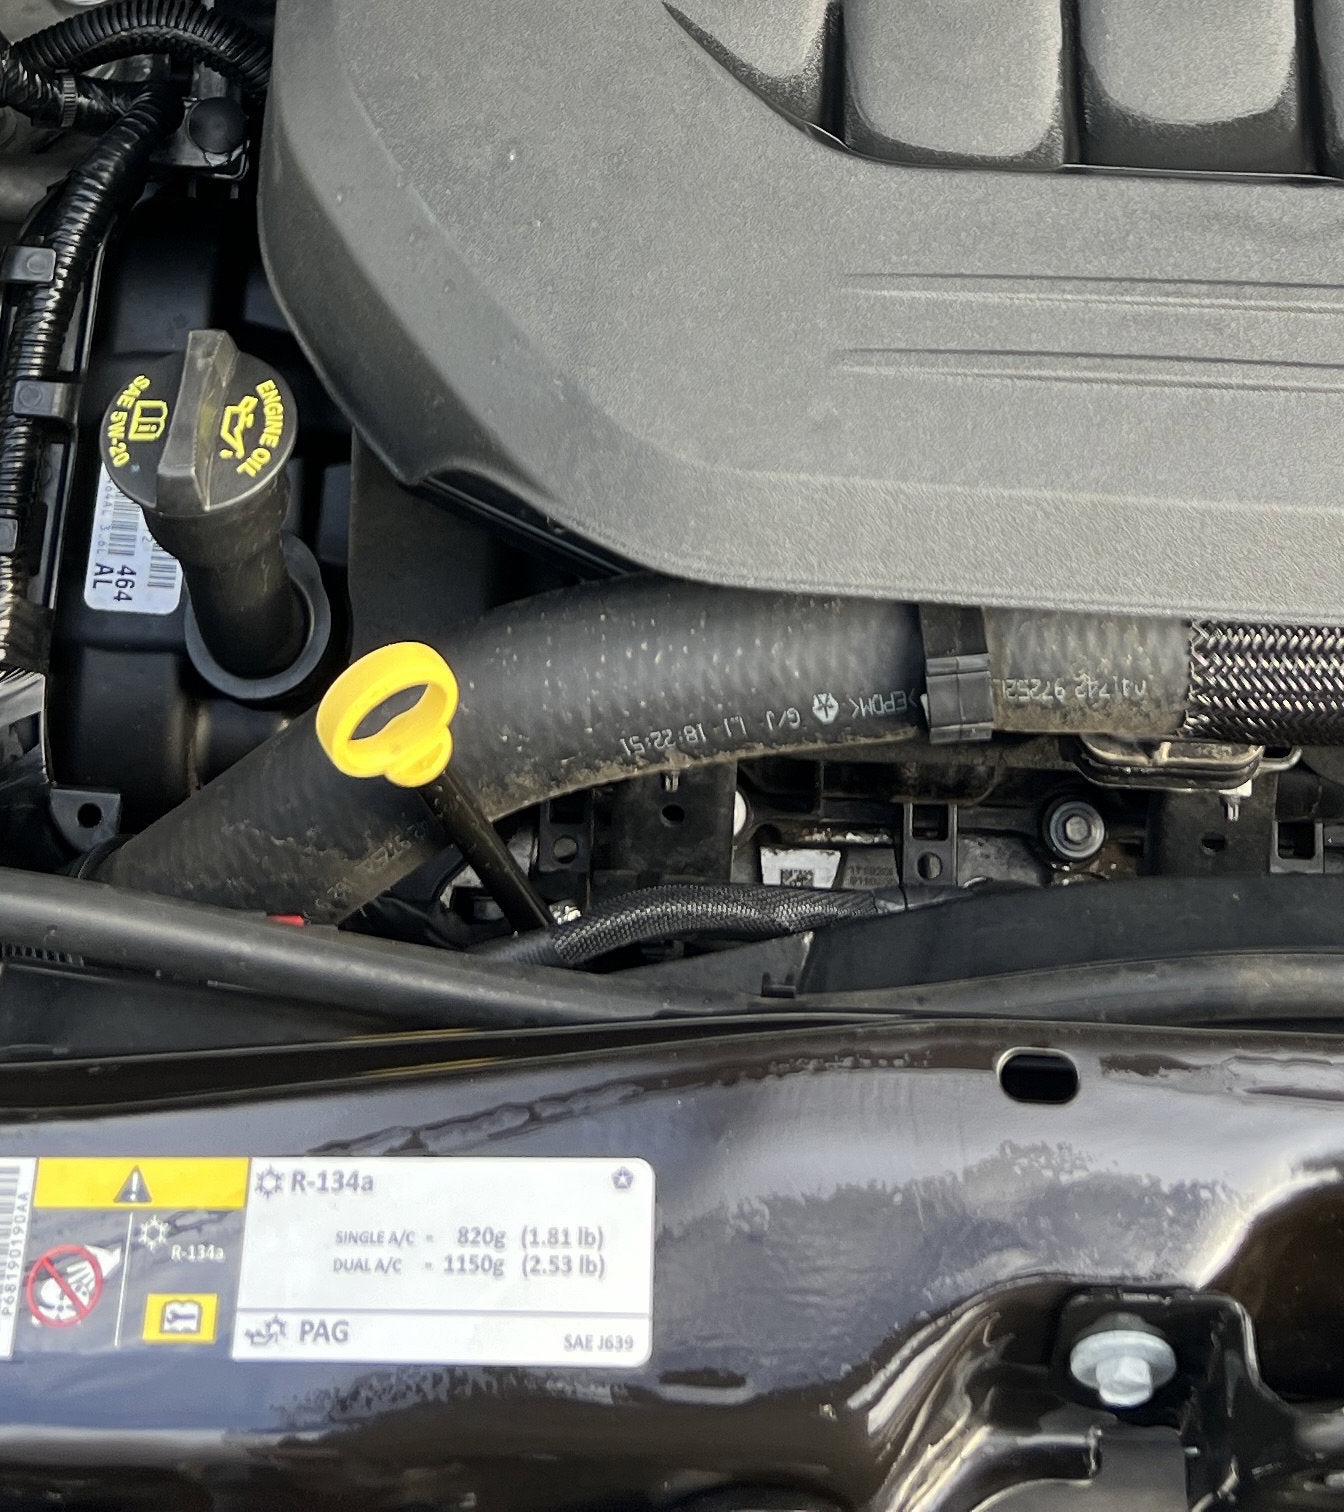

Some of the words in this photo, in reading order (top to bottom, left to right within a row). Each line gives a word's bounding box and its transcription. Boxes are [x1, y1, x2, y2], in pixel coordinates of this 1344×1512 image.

[117, 374, 152, 409] SAE
[256, 379, 284, 449] ENGINE
[107, 410, 130, 468] 5W-20
[236, 447, 271, 477] OIL
[92, 562, 114, 590] AL
[113, 564, 137, 602] 464
[289, 1170, 374, 1195] R-134a
[335, 1230, 385, 1245] SINGLE
[388, 1229, 415, 1248] A/C
[457, 1226, 506, 1249] 820g
[521, 1225, 571, 1251] (1.81
[578, 1225, 604, 1251] lb)
[170, 1244, 225, 1264] R-134a
[333, 1257, 372, 1273] DUAL
[374, 1257, 402, 1275] A/C
[444, 1254, 505, 1277] 1150g
[522, 1253, 572, 1279] (2.53
[579, 1253, 605, 1279] lb)
[299, 1320, 350, 1345] PAG
[563, 1334, 593, 1351] SAE
[596, 1334, 635, 1354] J639
